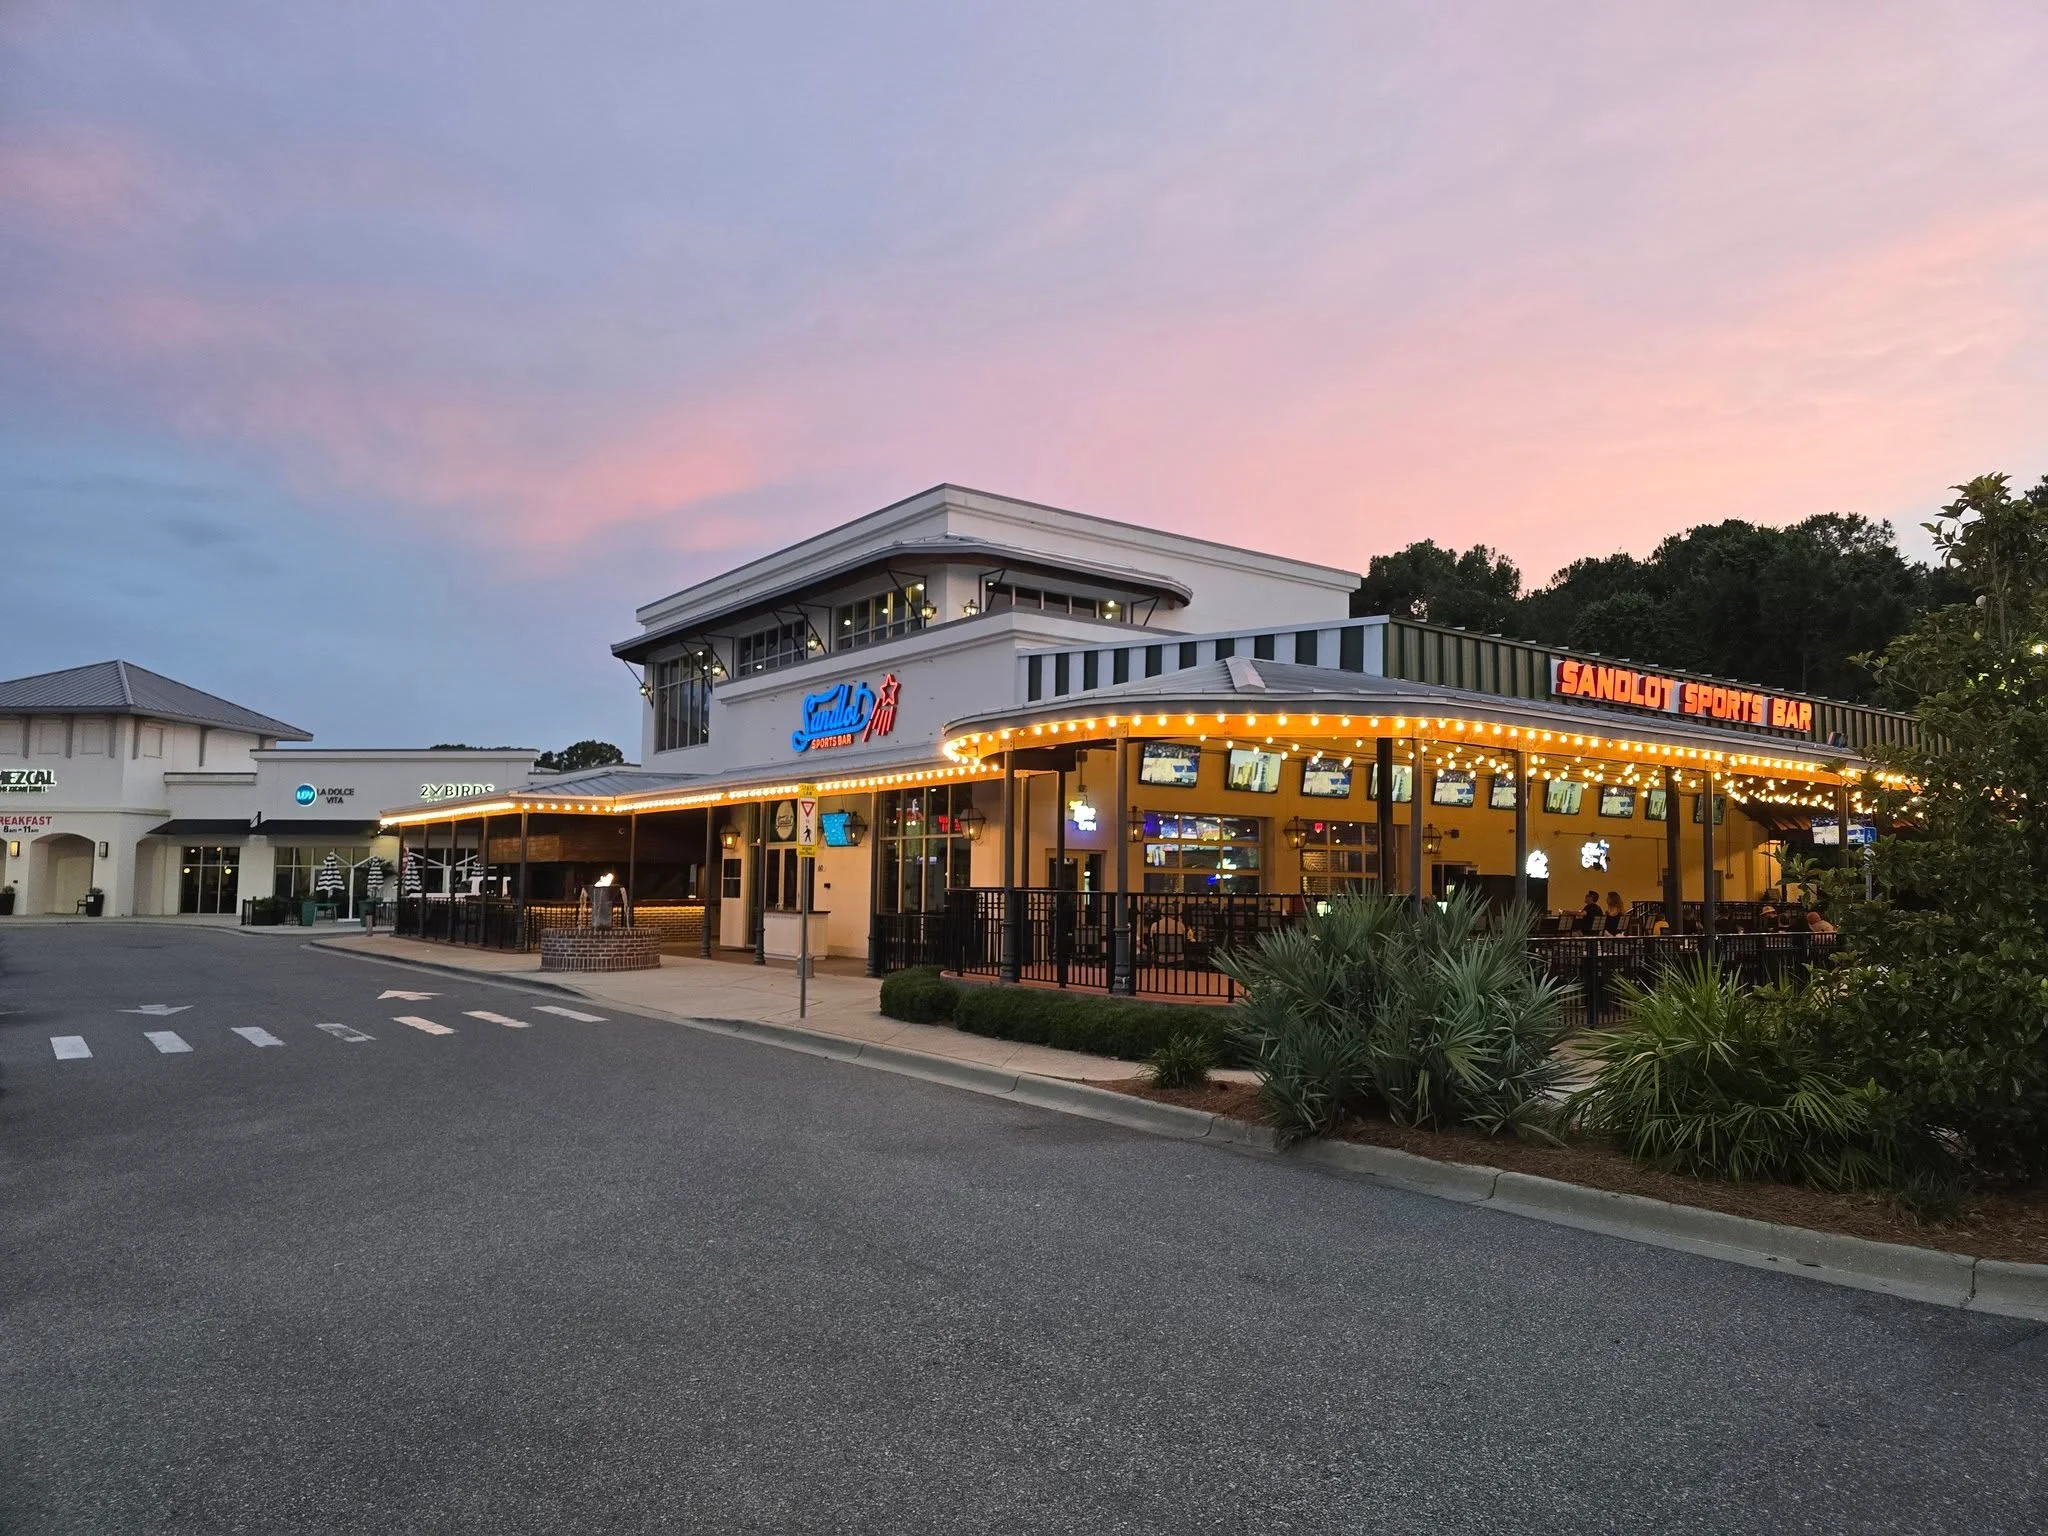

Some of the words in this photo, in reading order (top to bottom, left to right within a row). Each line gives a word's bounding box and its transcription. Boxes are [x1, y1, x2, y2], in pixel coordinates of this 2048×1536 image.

[1558, 660, 1675, 710] SANDLOT
[1680, 682, 1764, 724] SPORTS
[1769, 697, 1813, 731] BAR
[811, 735, 837, 750] SPORTS
[837, 733, 853, 746] BAR
[316, 788, 327, 796] LA
[327, 788, 355, 796] DOLCE
[325, 796, 344, 804] VITA
